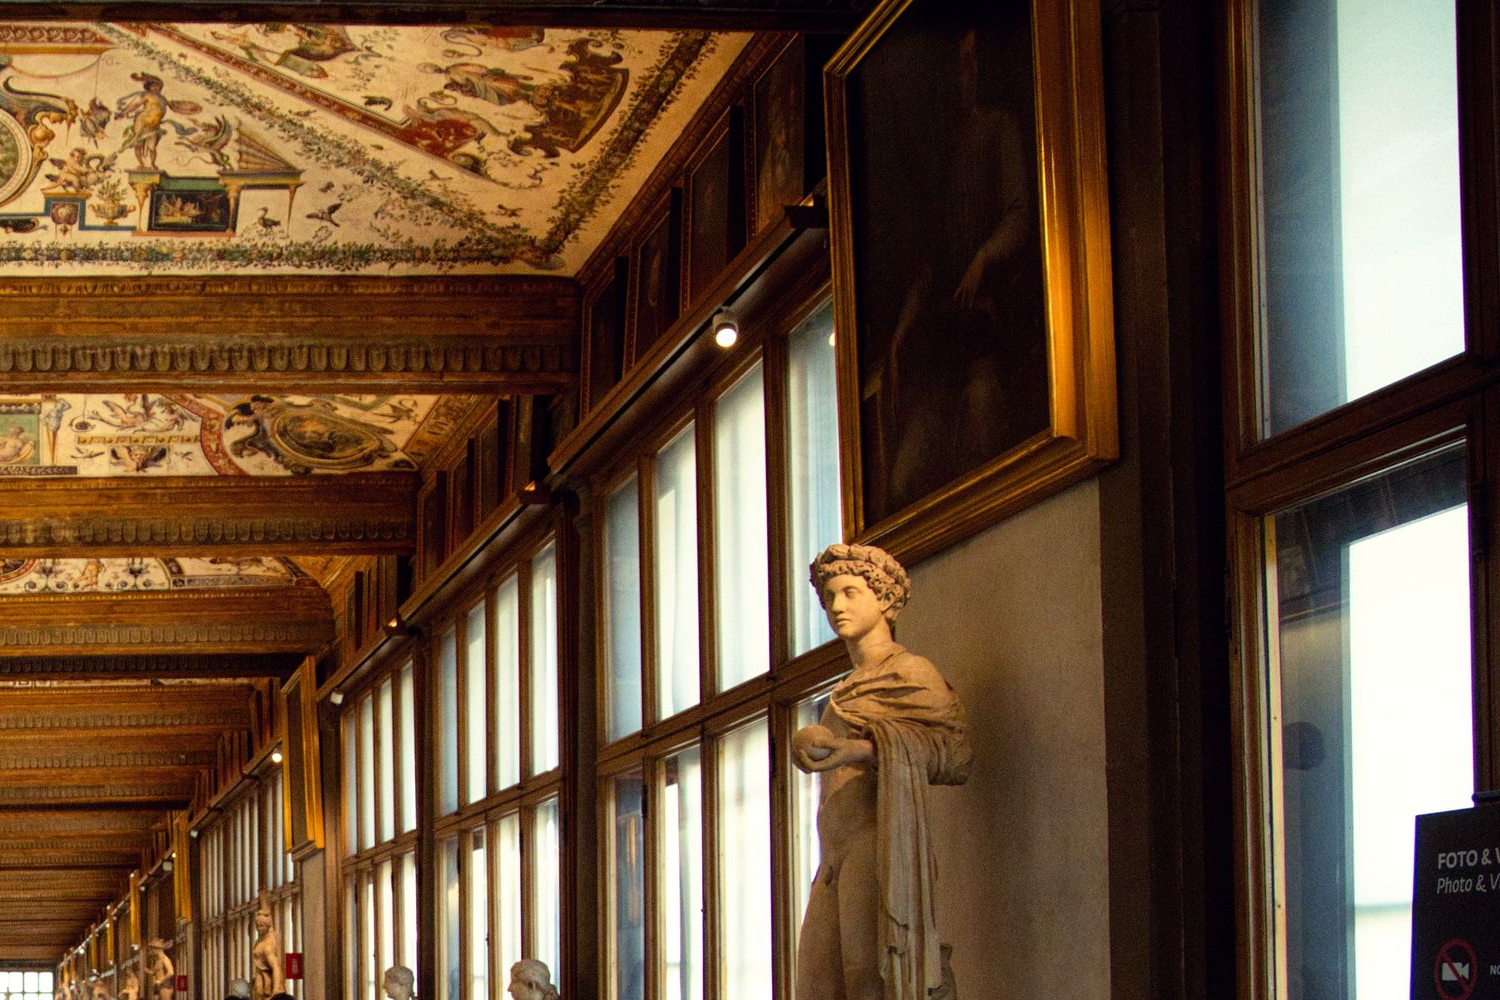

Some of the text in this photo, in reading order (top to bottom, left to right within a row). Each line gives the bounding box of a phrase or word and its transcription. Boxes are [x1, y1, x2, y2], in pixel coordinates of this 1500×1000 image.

[1438, 850, 1478, 869] FOTO
[1481, 847, 1492, 866] &
[1436, 873, 1500, 894] Photo & V
